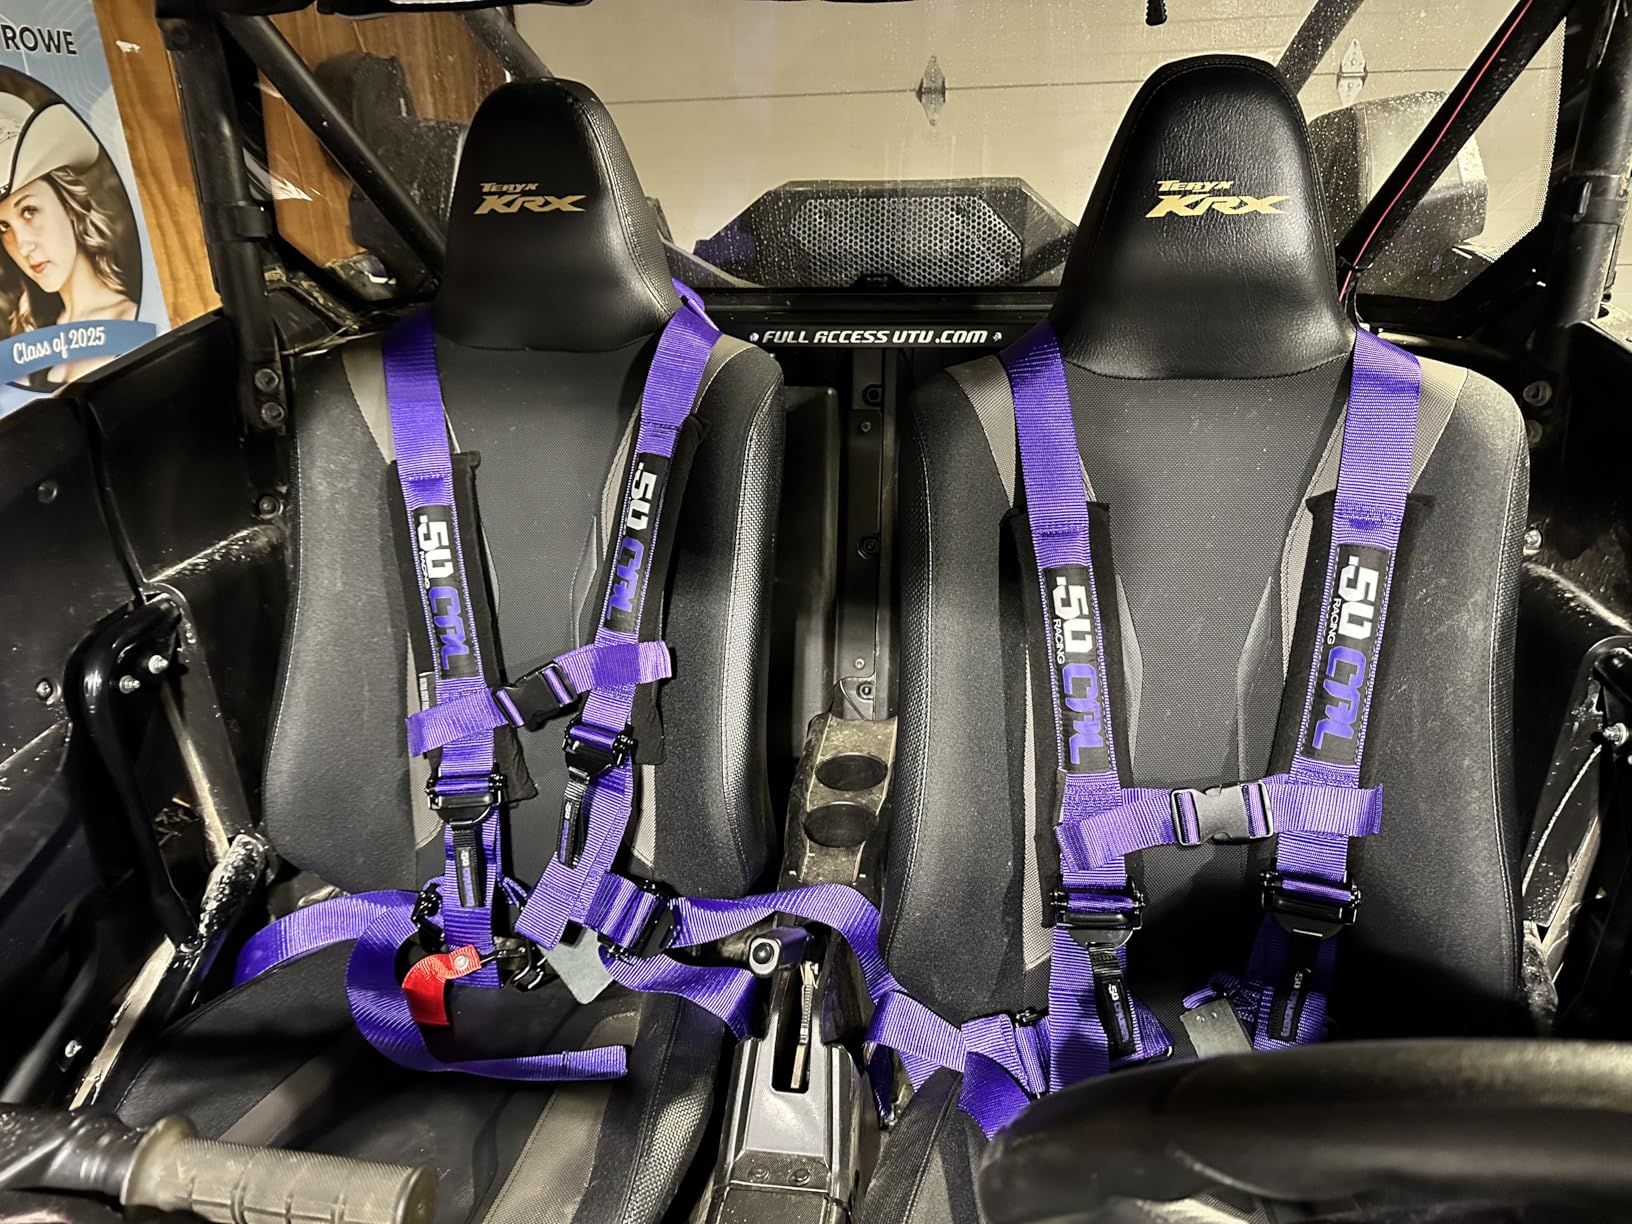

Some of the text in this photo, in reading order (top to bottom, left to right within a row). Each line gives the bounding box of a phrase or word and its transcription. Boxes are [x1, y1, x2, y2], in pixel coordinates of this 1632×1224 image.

[1, 24, 77, 55] ROWE
[473, 194, 587, 215] KRX
[1145, 194, 1290, 218] KRX
[13, 327, 105, 364] Class of 2025
[762, 330, 809, 344] FULL
[813, 330, 890, 344] ACCESS
[1327, 597, 1342, 645] RACING
[1052, 618, 1066, 665] RACING
